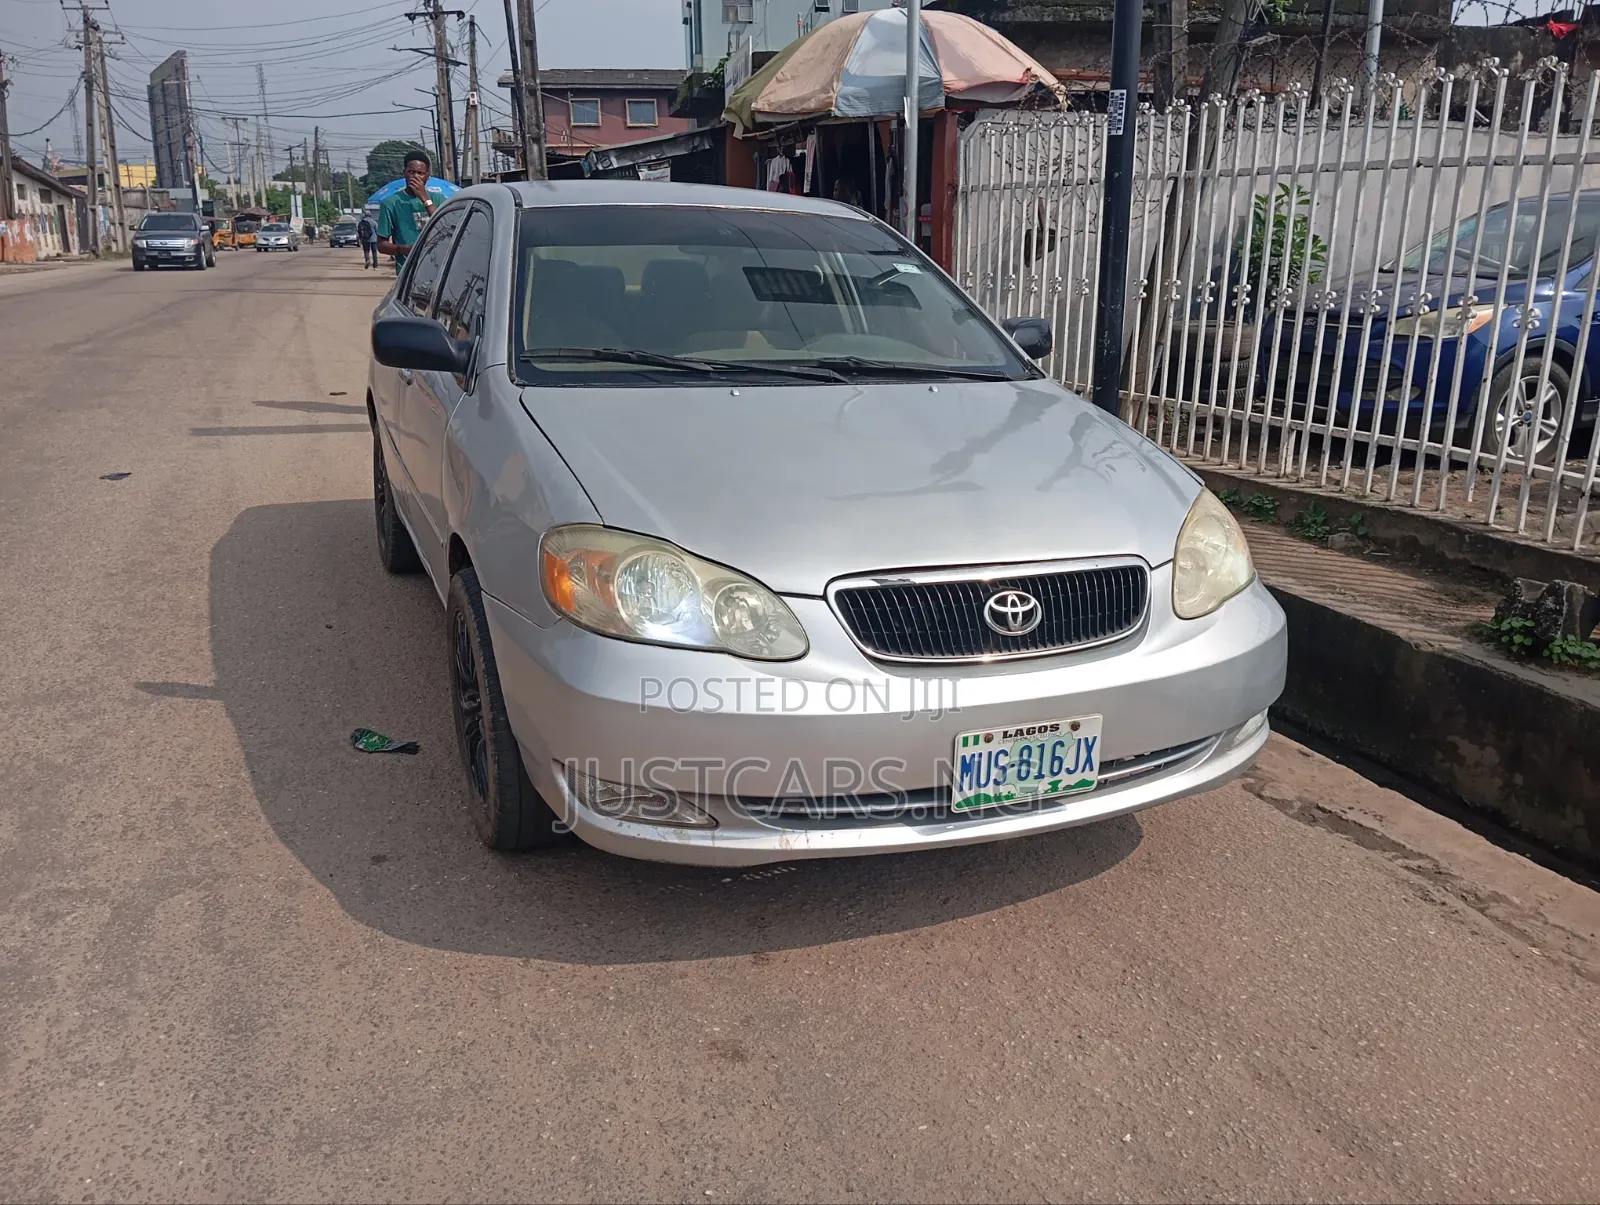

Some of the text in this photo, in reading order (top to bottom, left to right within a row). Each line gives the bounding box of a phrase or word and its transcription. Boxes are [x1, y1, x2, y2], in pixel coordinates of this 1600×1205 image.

[1116, 92, 1125, 134] HOTEL
[1002, 723, 1060, 739] LAGOS
[959, 735, 1098, 793] MUS-816JX
